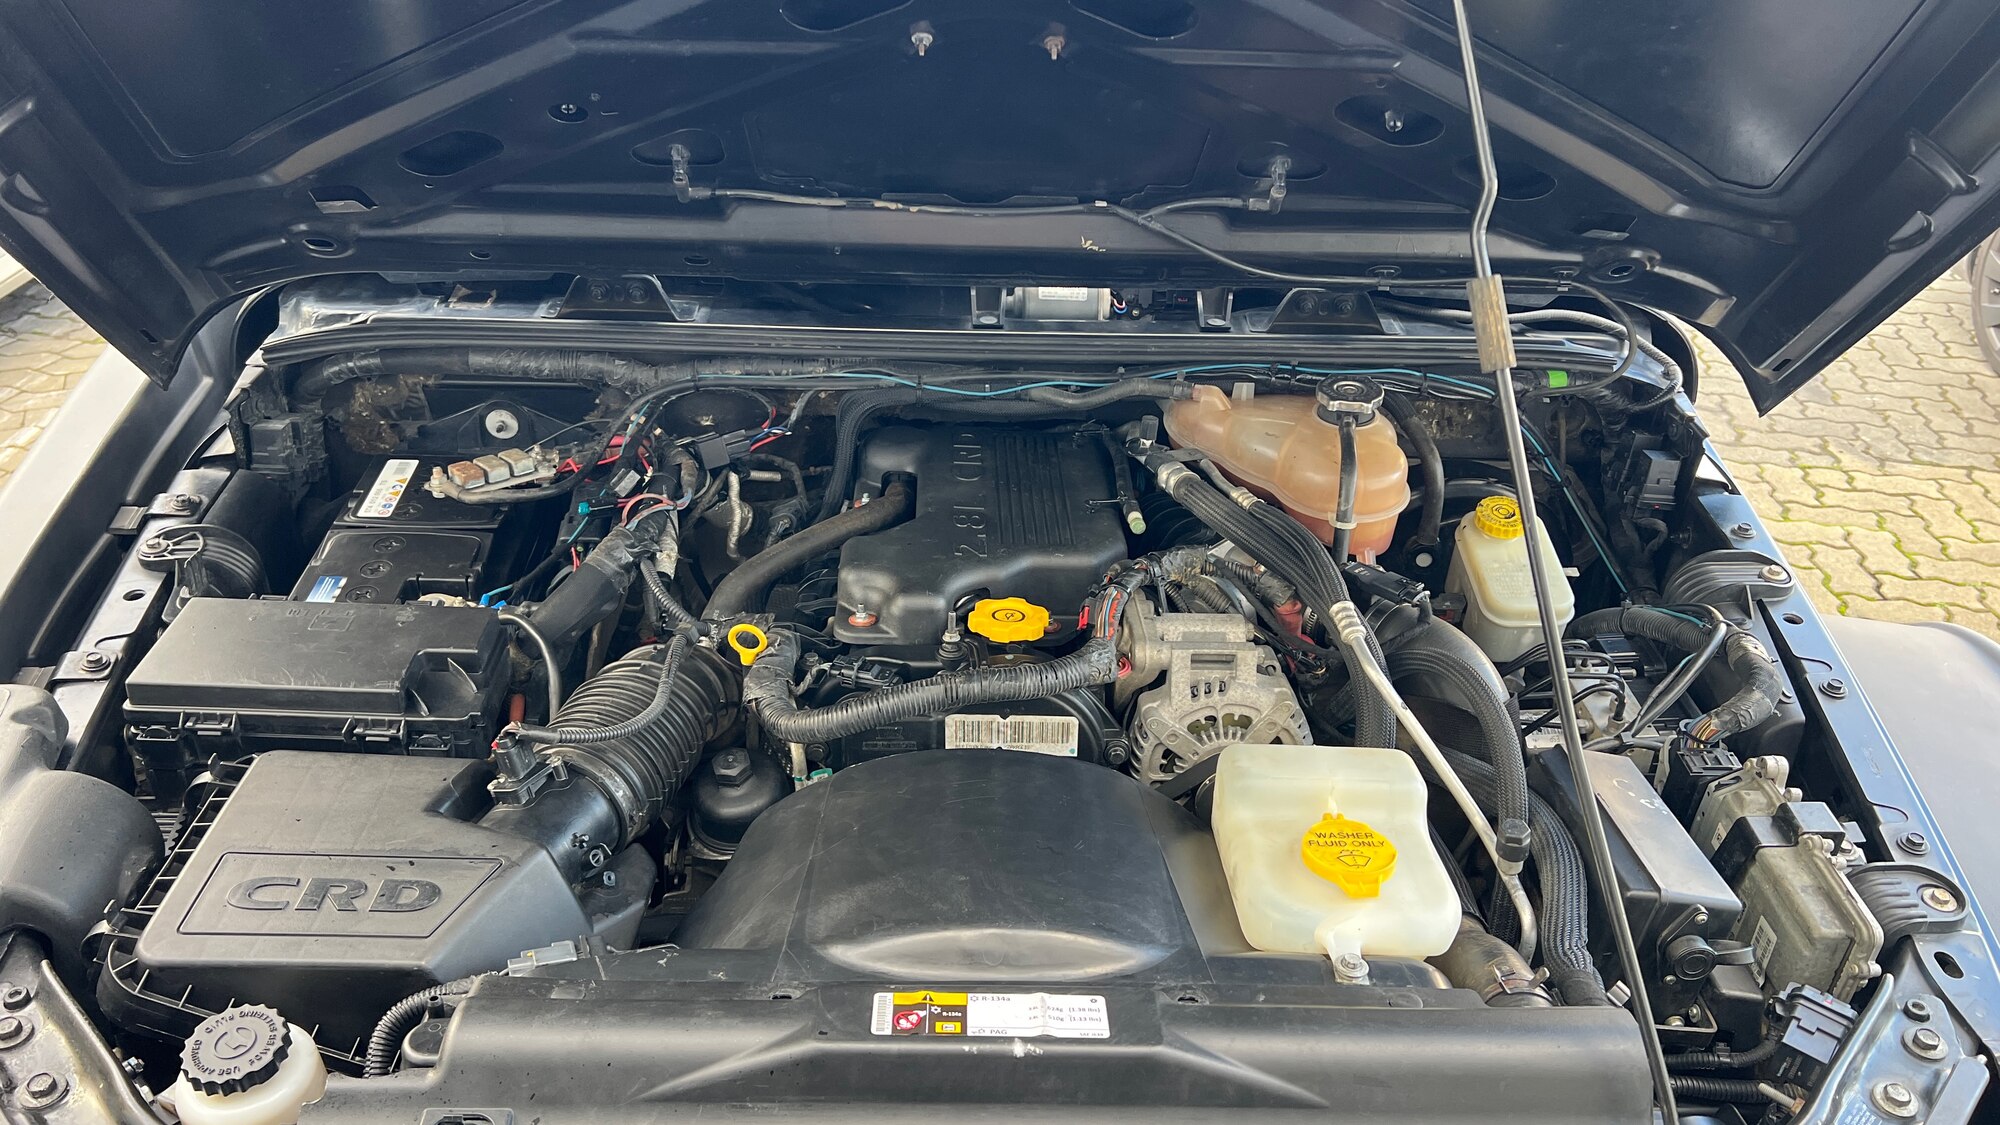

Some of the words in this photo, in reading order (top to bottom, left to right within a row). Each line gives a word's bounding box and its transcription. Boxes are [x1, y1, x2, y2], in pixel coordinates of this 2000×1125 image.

[951, 432, 982, 481] CRD
[226, 876, 442, 912] CRD
[204, 1014, 235, 1034] FLUID
[239, 1010, 278, 1033] STEERING
[190, 1039, 216, 1075] APPROVED
[248, 1034, 277, 1066] POWER
[217, 1065, 241, 1076] USE
